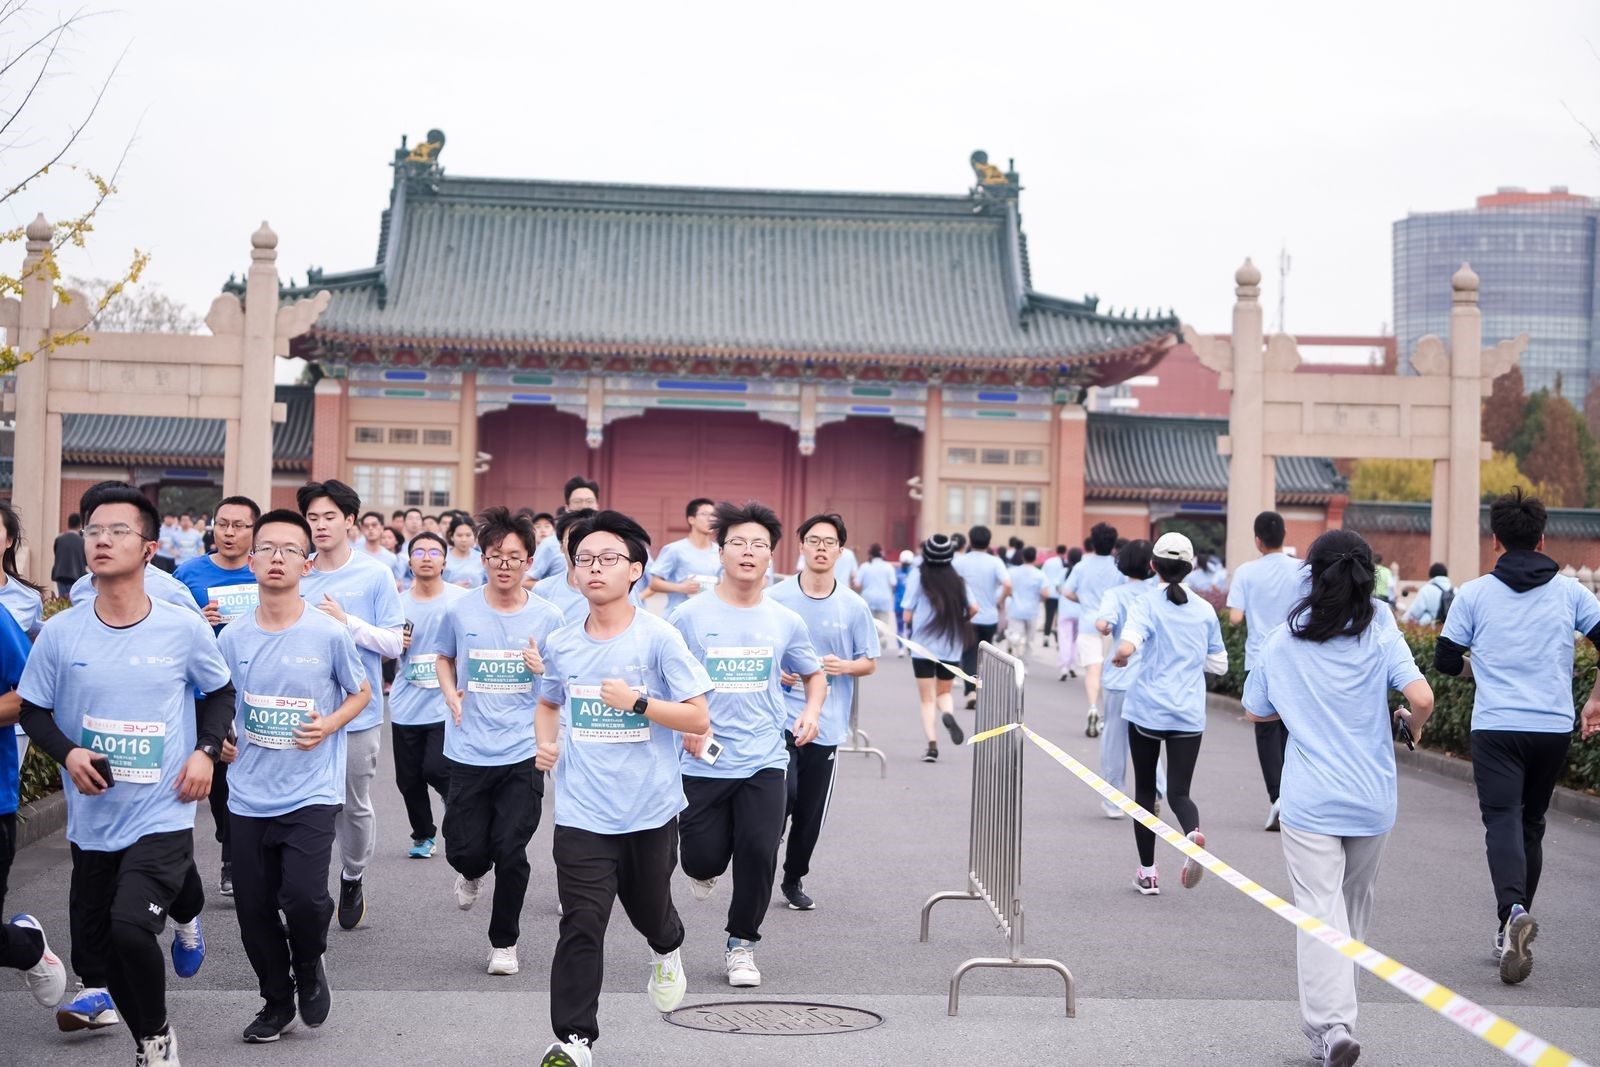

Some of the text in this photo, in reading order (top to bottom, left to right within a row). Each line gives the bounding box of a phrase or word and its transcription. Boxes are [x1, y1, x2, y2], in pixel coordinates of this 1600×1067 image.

[477, 661, 525, 674] A0156
[716, 659, 765, 672] A0425
[275, 699, 308, 708] BYD
[249, 709, 301, 726] A0128
[123, 724, 159, 733] BYD
[91, 734, 151, 755] A0116
